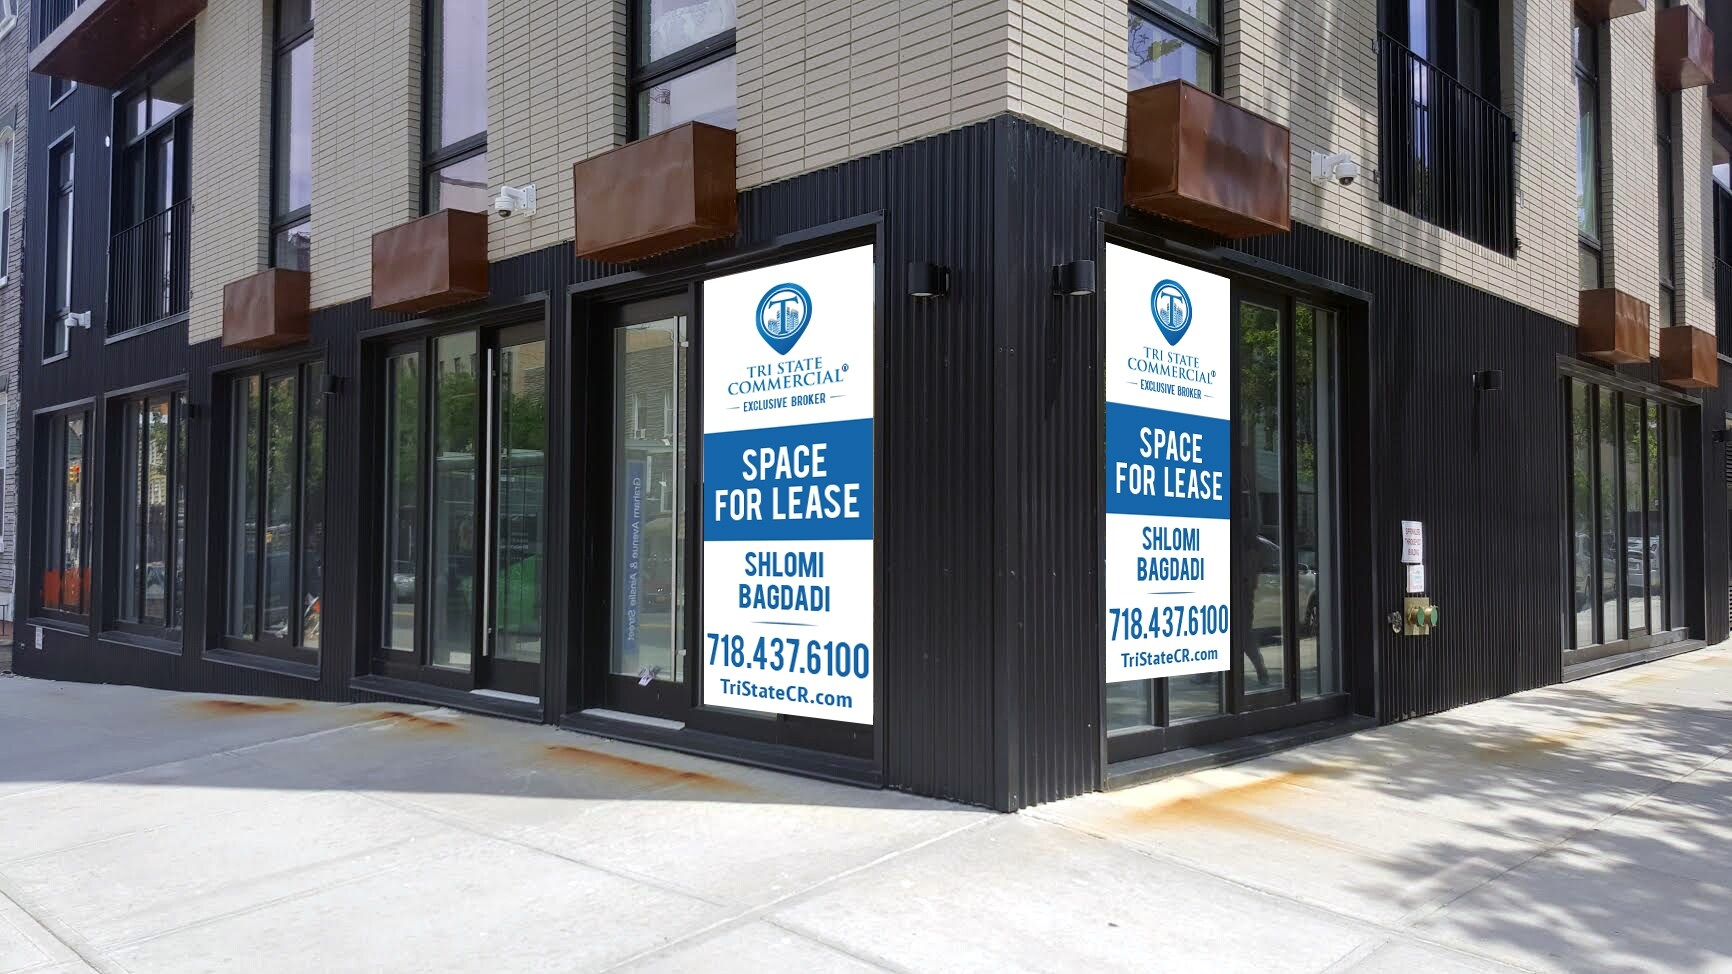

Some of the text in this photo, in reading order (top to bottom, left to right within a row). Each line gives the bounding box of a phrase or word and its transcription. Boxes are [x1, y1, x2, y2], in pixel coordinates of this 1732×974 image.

[768, 296, 799, 334] T
[1161, 291, 1183, 328] T
[747, 357, 822, 378] TRI STATE
[1144, 347, 1199, 368] TRI STATE
[744, 393, 825, 412] EXCLUSIVE BROKER
[1141, 379, 1201, 399] EXCLUSIVE BROKER
[1140, 427, 1202, 463] SPACE
[743, 443, 826, 481] SPACE
[1117, 462, 1222, 500] FOR LEASE
[716, 484, 859, 521] FOR LEASE
[1142, 526, 1199, 551] SHLOMI
[745, 552, 824, 578] SHLOMI
[1137, 557, 1204, 581] BAGDADI
[739, 584, 830, 612] BAGDADI
[1109, 604, 1228, 641] 718.437.6100
[707, 633, 869, 679] 718.437.6100
[1121, 648, 1218, 668] TriStateCR.com
[720, 678, 852, 708] TriStateCR.com
